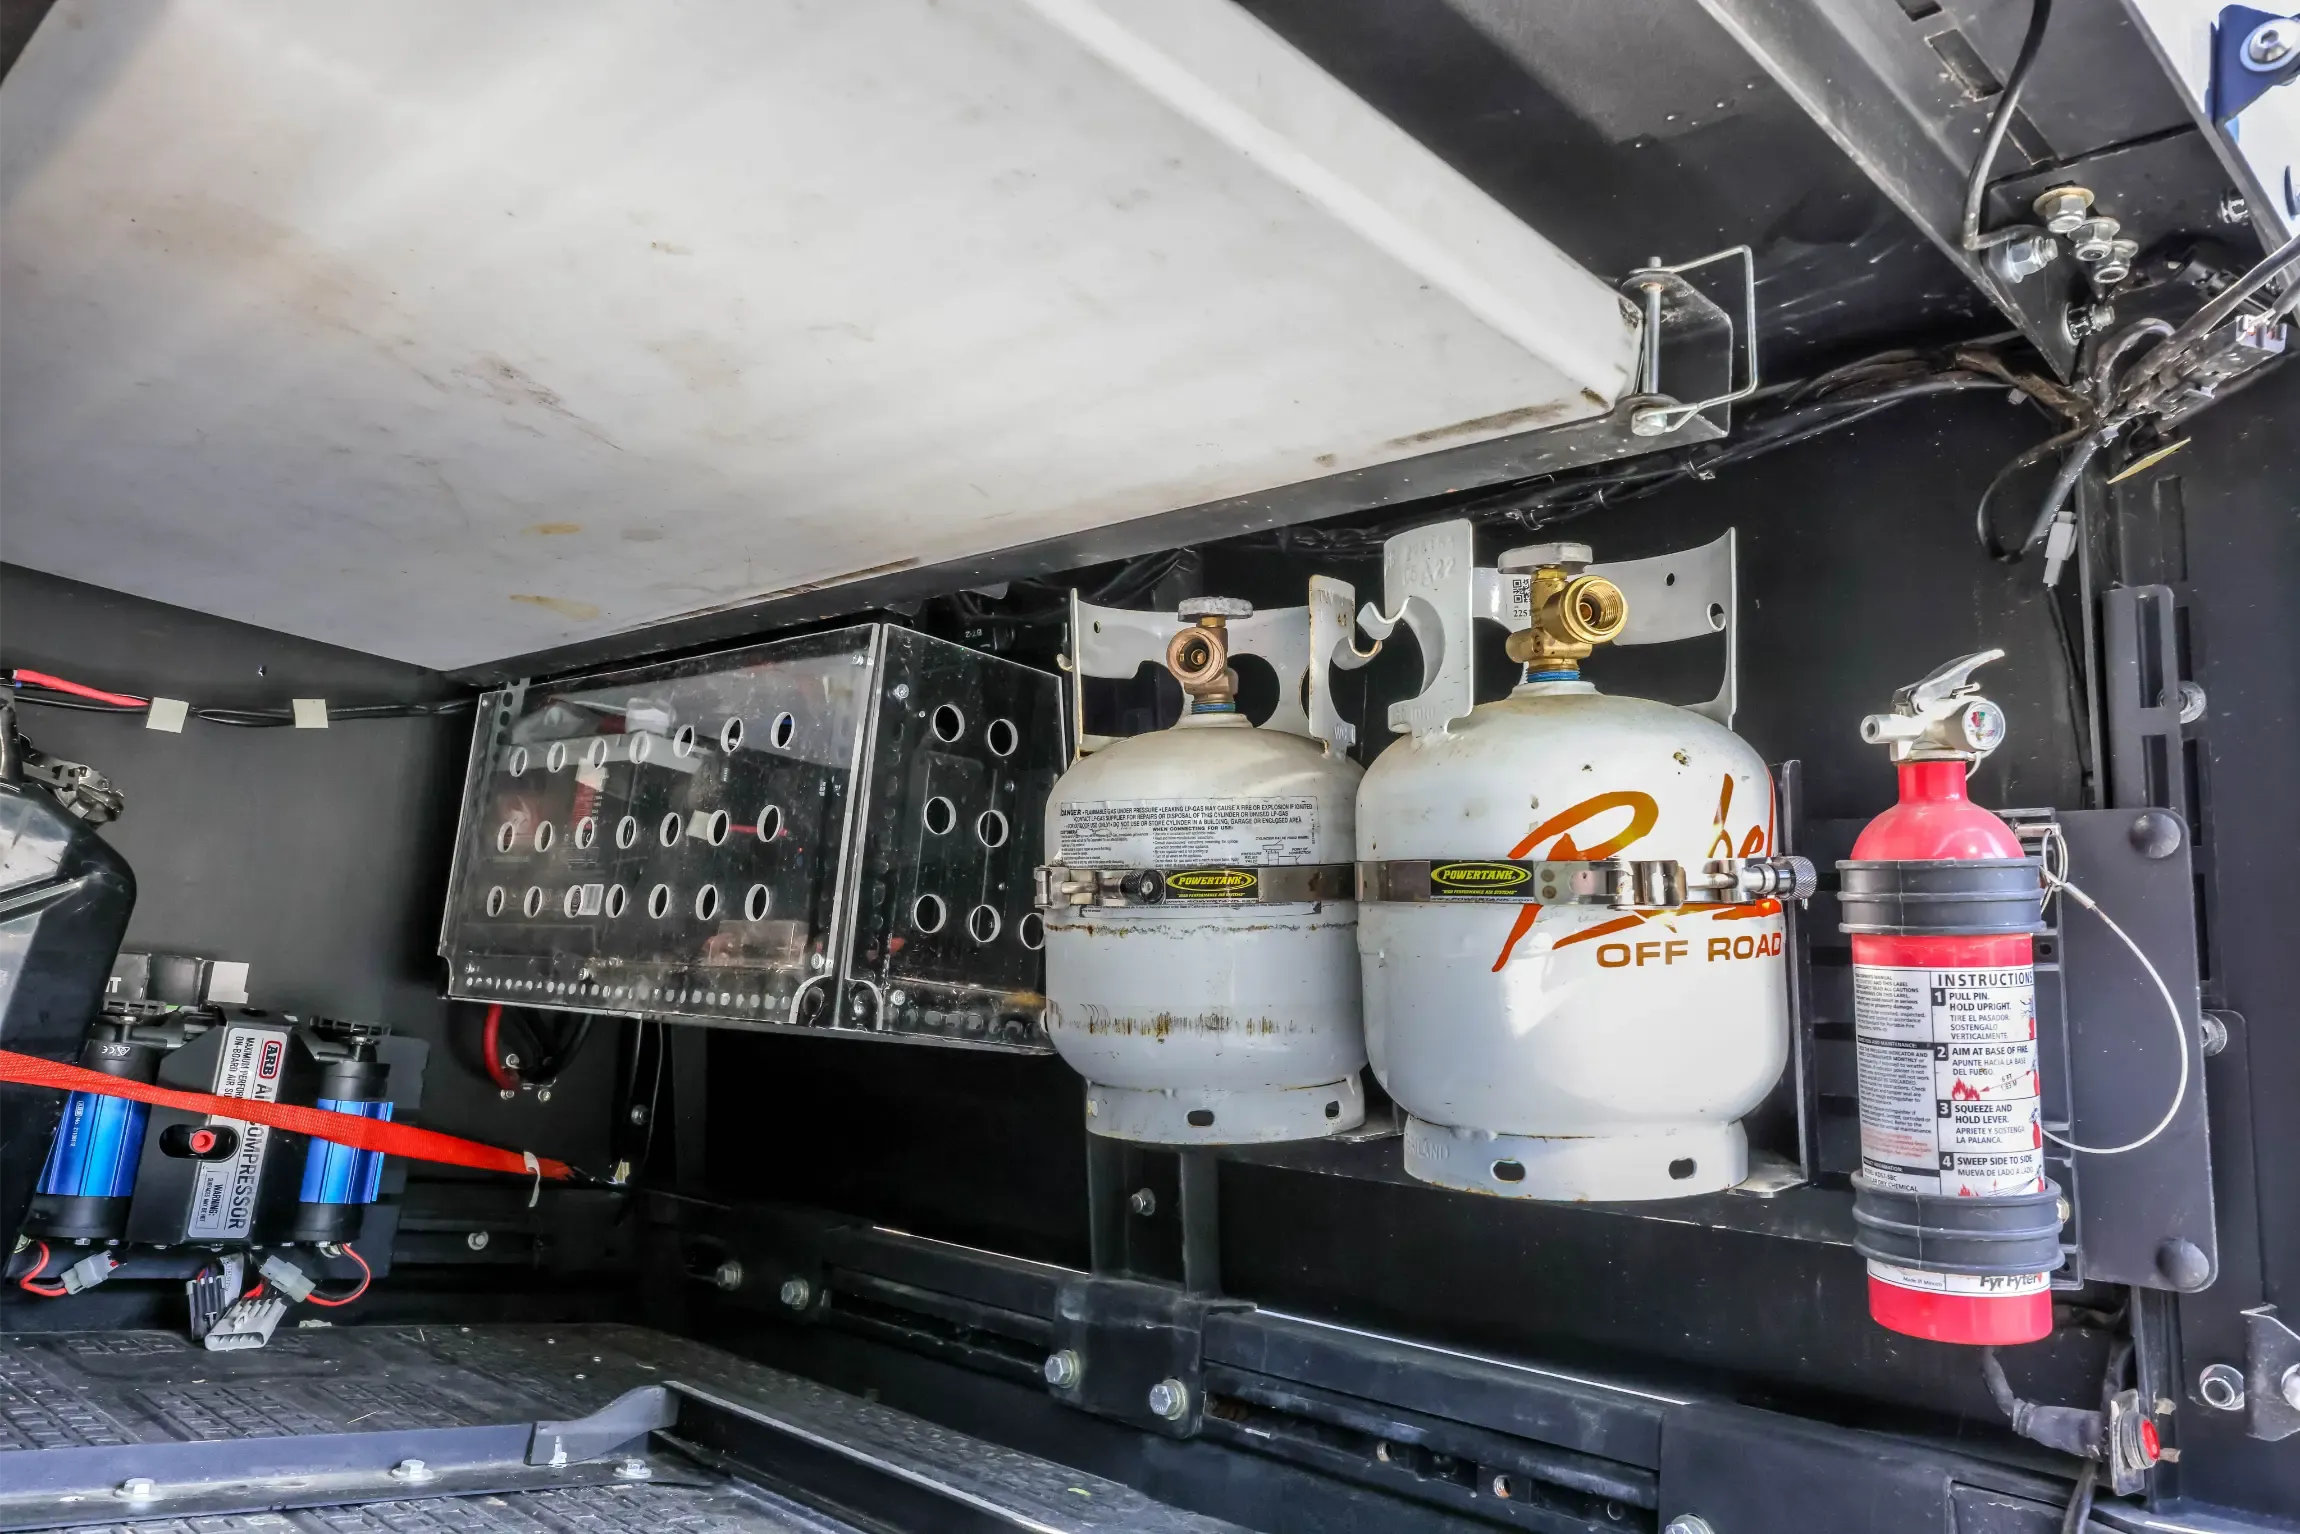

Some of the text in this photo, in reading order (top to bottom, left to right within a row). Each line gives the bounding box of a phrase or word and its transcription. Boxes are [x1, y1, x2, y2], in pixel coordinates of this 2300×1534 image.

[1596, 932, 1782, 968] OFF ROAD
[1938, 971, 2033, 987] INSTRUCTIONS
[1934, 991, 1943, 1003] 1
[1949, 992, 1990, 1000] PULL PIN.
[1949, 1002, 2012, 1011] HOLD UPRIGHT.
[1950, 1023, 1998, 1031] SOSTENGALO
[229, 1036, 244, 1072] ON-BOARD
[241, 1037, 256, 1071] MAXIMUM
[1937, 1046, 1946, 1058] 2
[1952, 1047, 1970, 1056] AIM
[1972, 1047, 1983, 1055] AT
[1985, 1046, 2005, 1055] BASE
[2006, 1046, 2015, 1054] OF
[263, 1044, 279, 1076] ARB
[1952, 1059, 1982, 1067] APUNTE
[1984, 1058, 2004, 1066] HACIA
[2014, 1057, 2026, 1065] BASE
[1952, 1068, 1968, 1076] DEL
[225, 1073, 237, 1086] AIR
[1940, 1103, 1949, 1115] 3
[1954, 1104, 2013, 1114] SQUEEZE AND
[1955, 1115, 1981, 1124] HOLD
[1956, 1136, 1966, 1144] LA
[1941, 1155, 1952, 1167] 4
[1957, 1157, 1988, 1166] SWEEP
[1989, 1156, 2008, 1165] SIDE
[2009, 1156, 2019, 1164] TO
[228, 1121, 265, 1230] OMPRESSOR
[1888, 1182, 1919, 1192] CHEMICAL
[208, 1184, 224, 1216] WARNING:
[1980, 1274, 2038, 1291] Fyr Fyter
